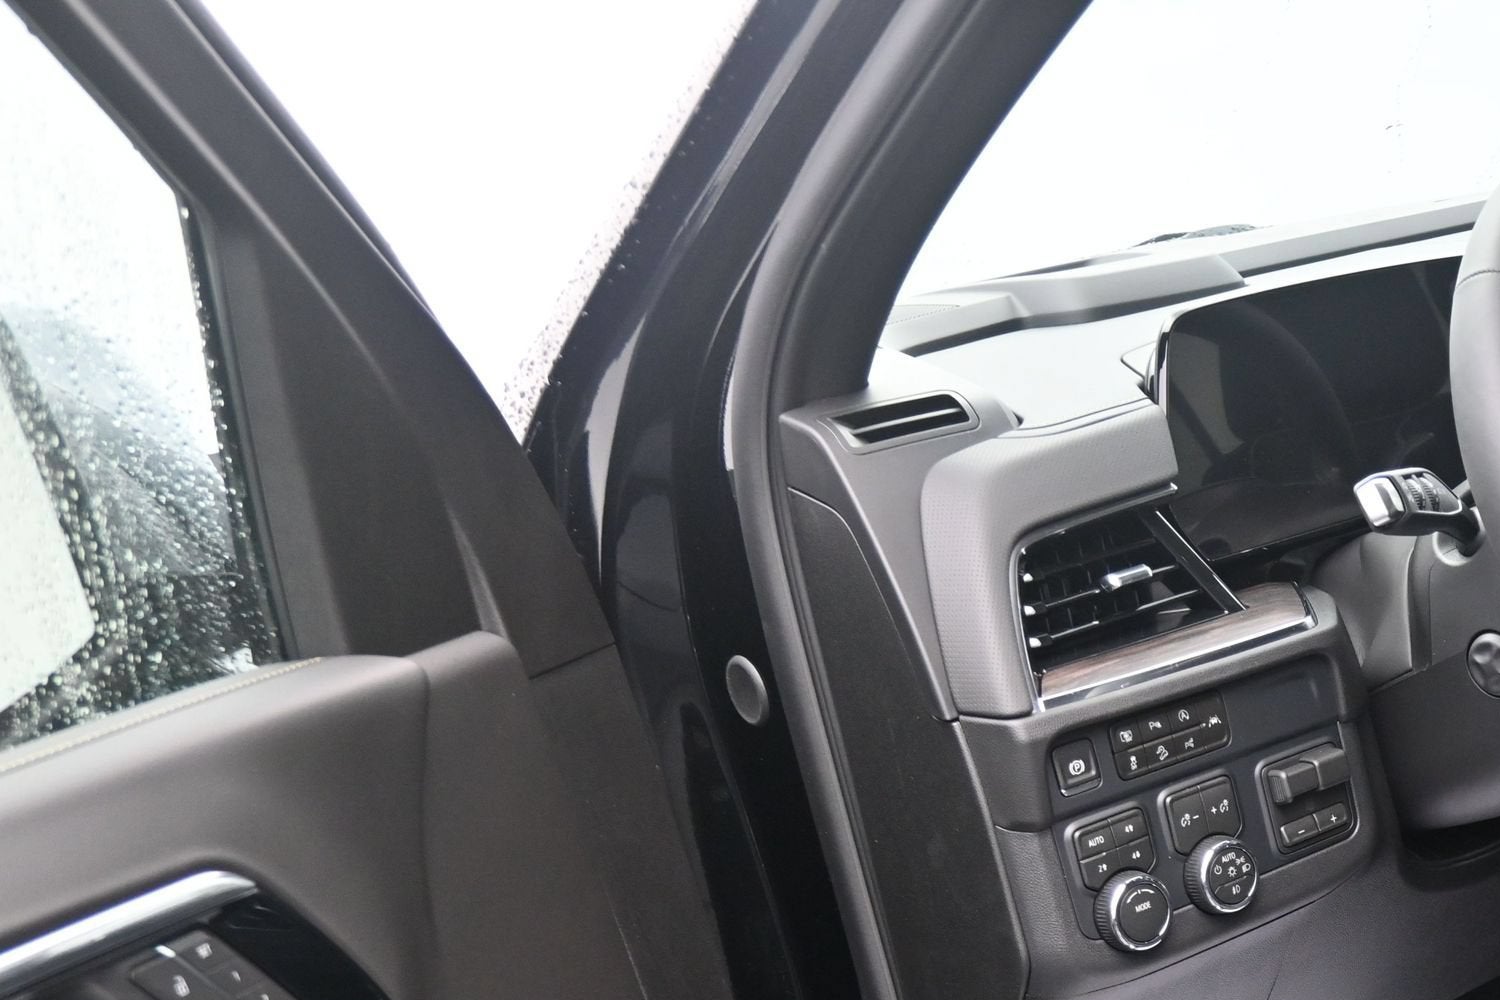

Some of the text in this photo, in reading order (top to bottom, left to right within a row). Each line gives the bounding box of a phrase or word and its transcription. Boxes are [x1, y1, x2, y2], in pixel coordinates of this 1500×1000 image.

[1088, 836, 1105, 848] AUTO
[1221, 852, 1236, 864] AUTO
[1135, 901, 1152, 913] MODE
